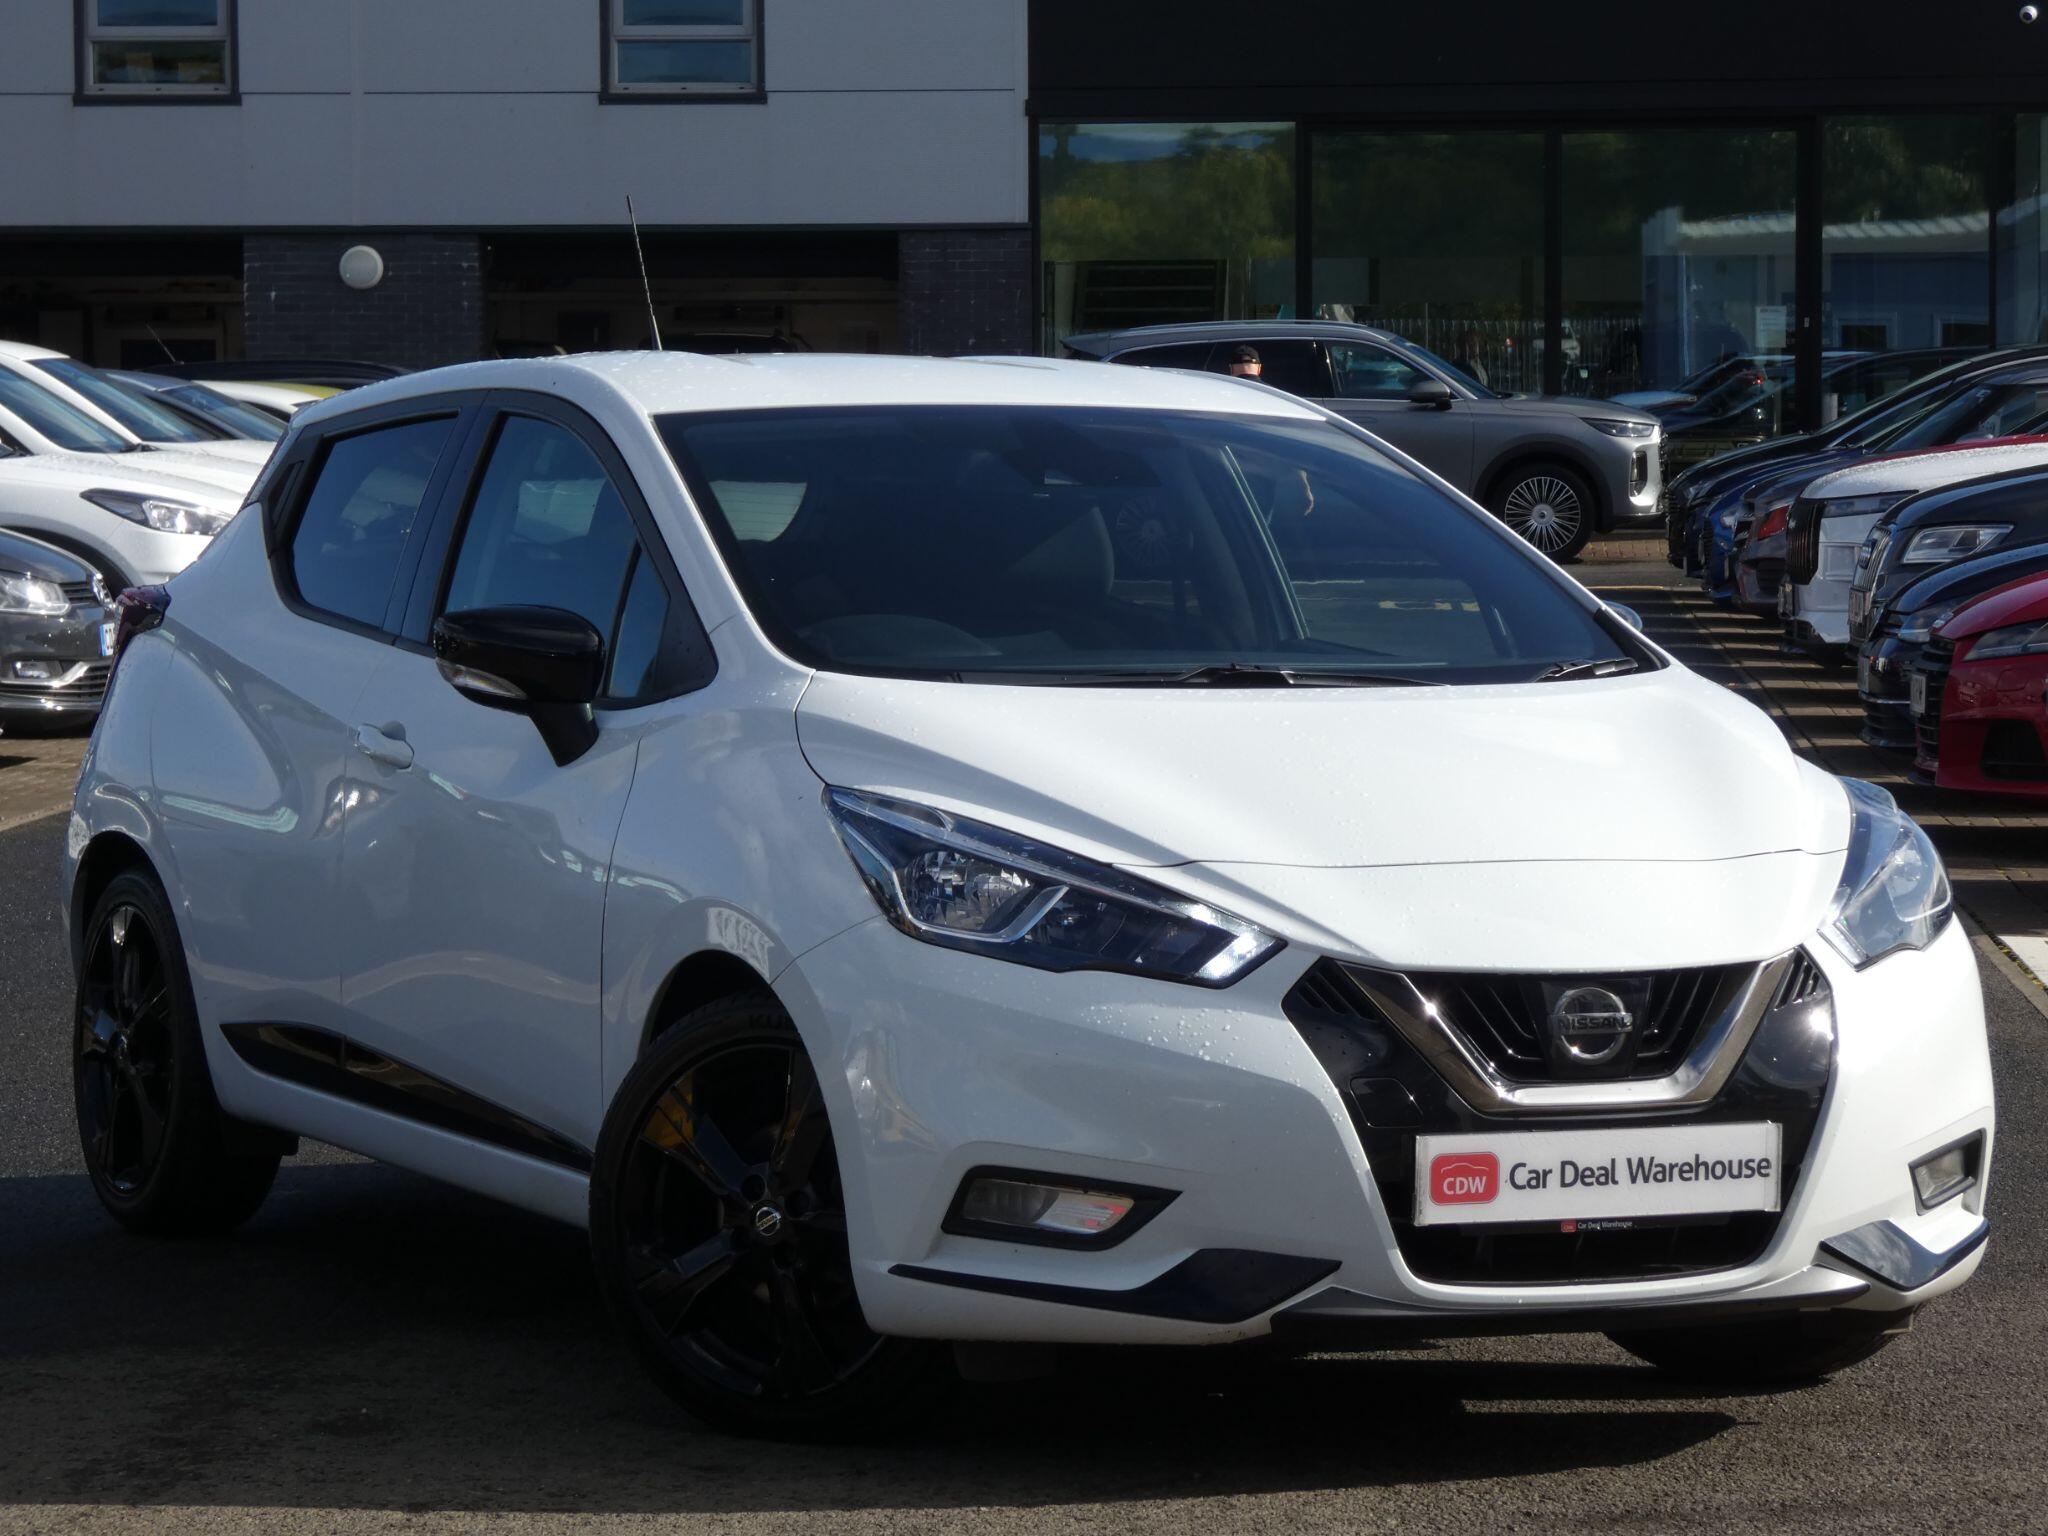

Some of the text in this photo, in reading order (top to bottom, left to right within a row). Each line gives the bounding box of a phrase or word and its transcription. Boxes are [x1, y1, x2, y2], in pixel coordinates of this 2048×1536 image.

[1443, 1176, 1487, 1195] CDW
[1509, 1153, 1772, 1190] Car Deal Warehouse
